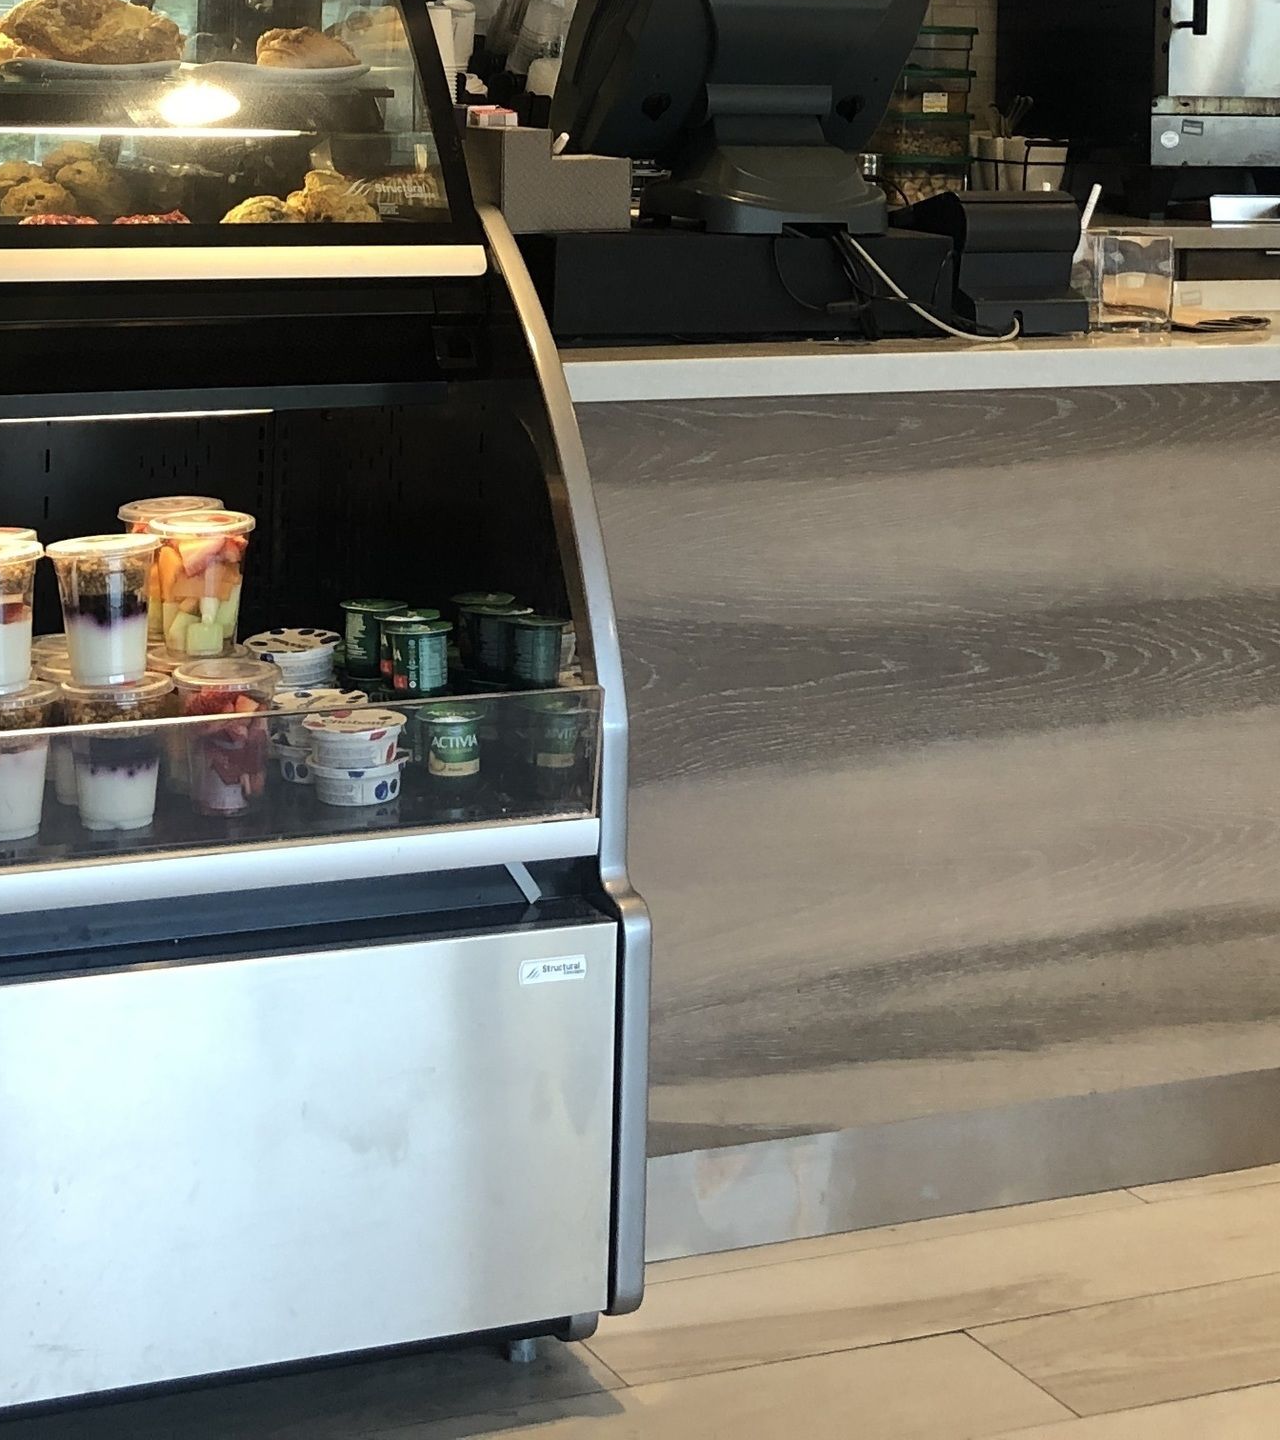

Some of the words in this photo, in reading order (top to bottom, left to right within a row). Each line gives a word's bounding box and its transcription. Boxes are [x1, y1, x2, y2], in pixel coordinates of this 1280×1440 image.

[374, 182, 426, 193] Structural
[431, 734, 479, 749] ACTIVIA
[542, 961, 581, 973] Structural
